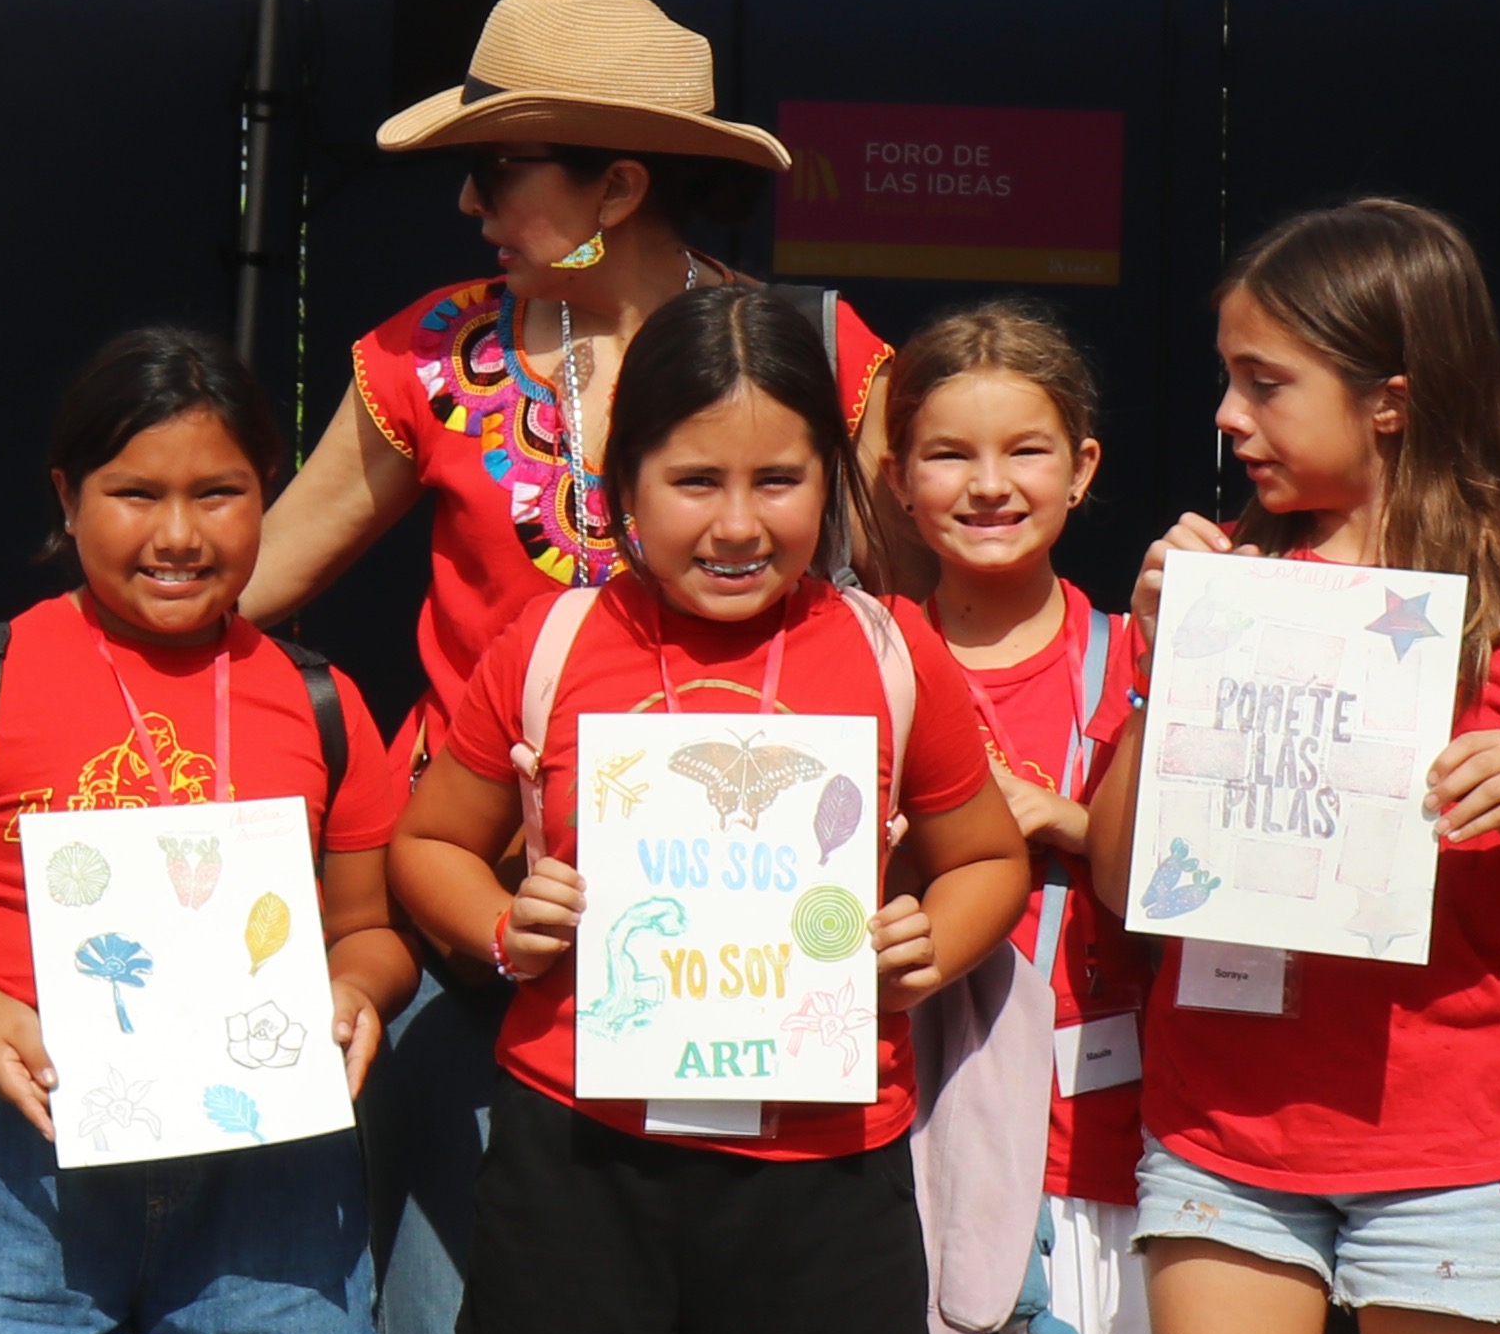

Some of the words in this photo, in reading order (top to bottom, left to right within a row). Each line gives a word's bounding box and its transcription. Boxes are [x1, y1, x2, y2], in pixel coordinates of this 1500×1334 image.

[865, 142, 943, 166] FORO
[953, 144, 992, 167] DE
[864, 172, 917, 194] LAS
[927, 174, 1012, 198] IDEAS
[1255, 731, 1320, 790] LAS
[1222, 778, 1337, 839] PILAS
[638, 837, 711, 889] VOS
[721, 841, 798, 893] SOS
[660, 947, 708, 1000] YO
[719, 943, 792, 999] SOY
[1214, 968, 1249, 981] Soraya
[674, 1038, 777, 1079] ART
